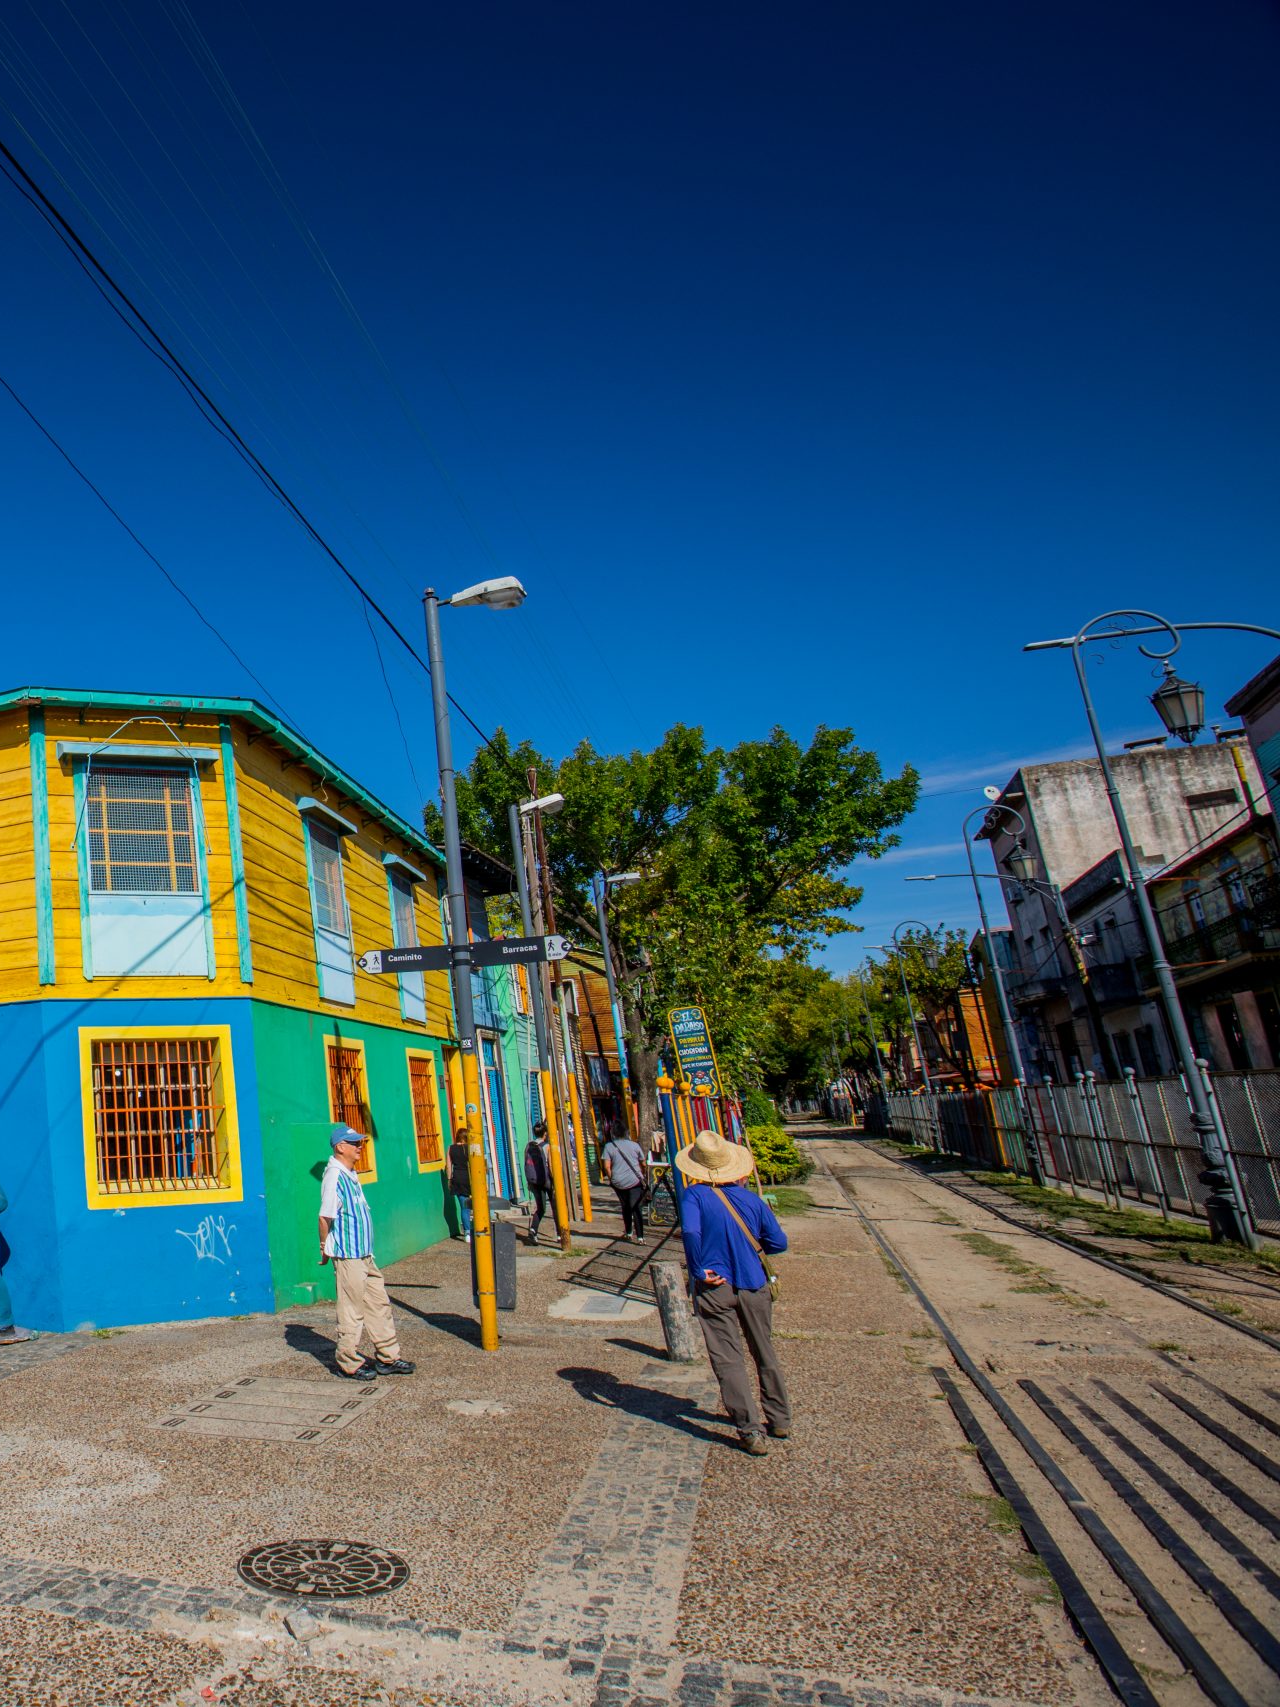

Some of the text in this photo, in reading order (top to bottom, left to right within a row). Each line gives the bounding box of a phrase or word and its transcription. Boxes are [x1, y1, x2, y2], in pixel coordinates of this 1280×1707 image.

[502, 944, 538, 954] Barracas
[388, 953, 423, 962] Caminito
[682, 1011, 692, 1021] EL
